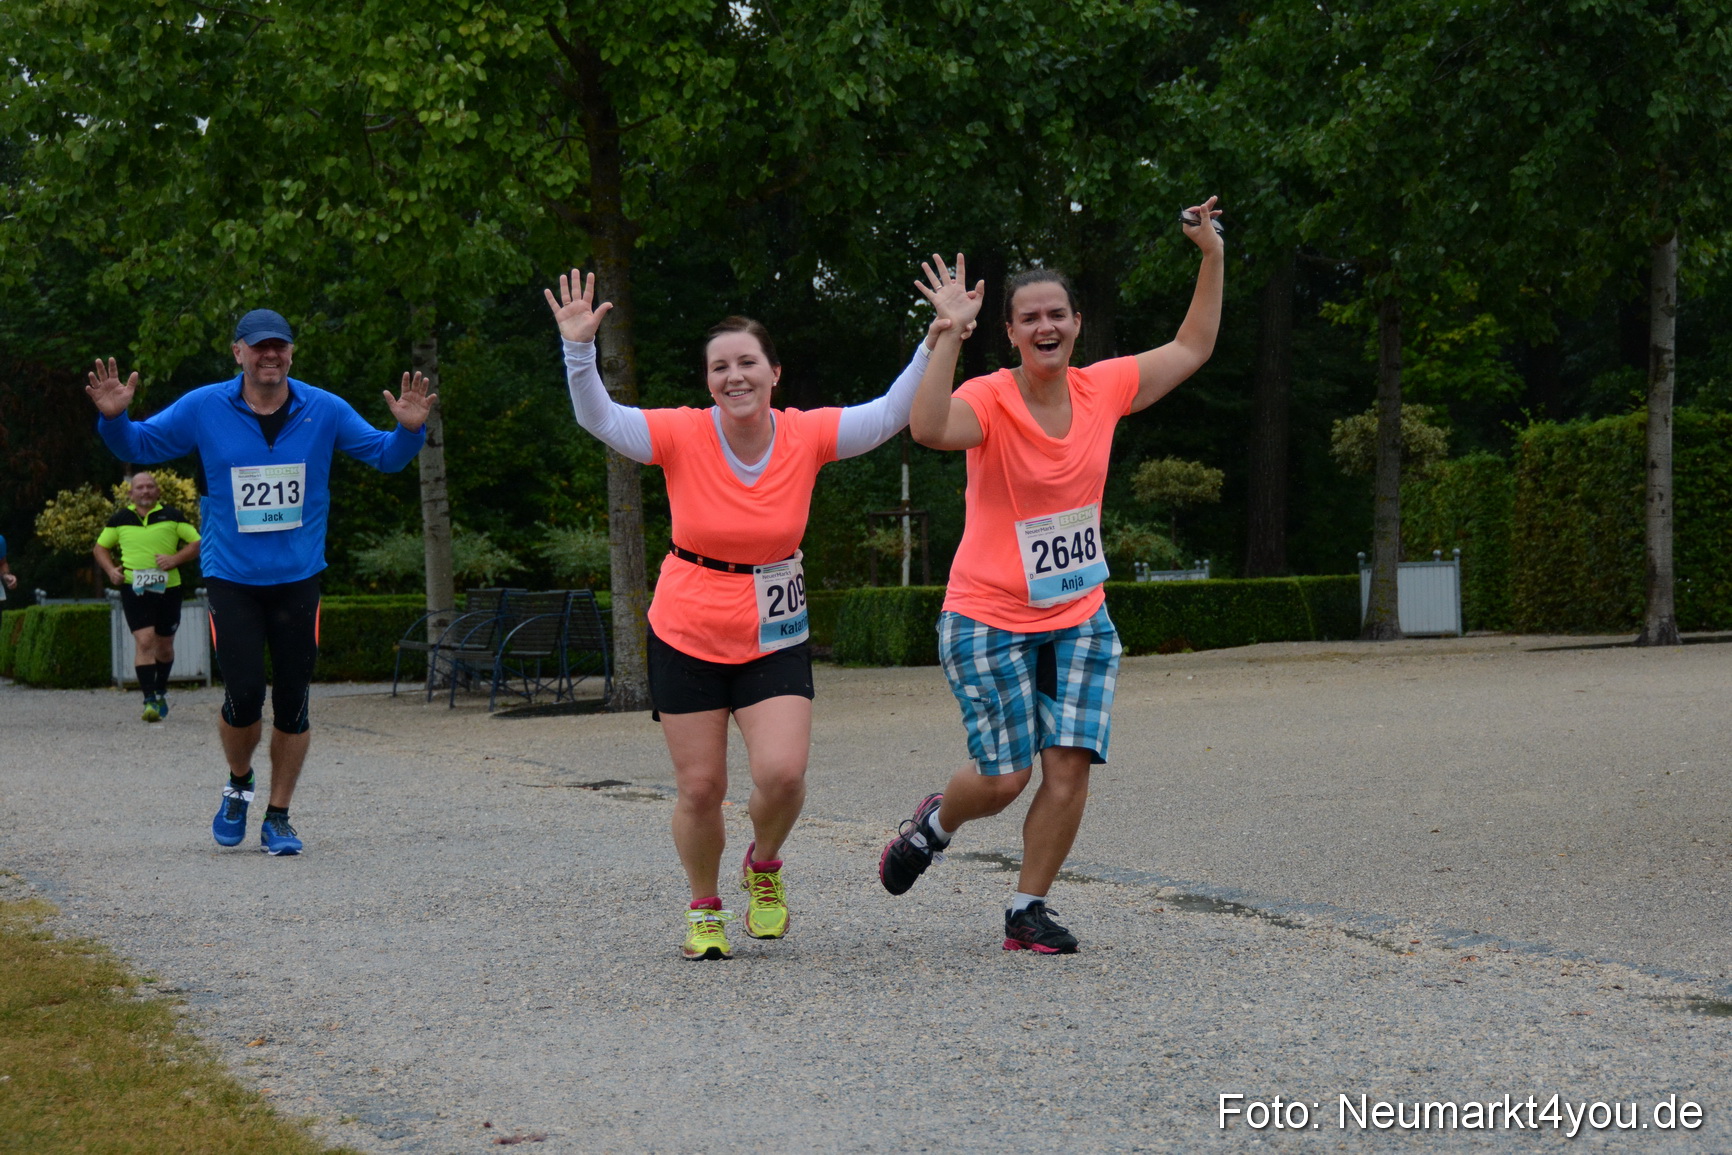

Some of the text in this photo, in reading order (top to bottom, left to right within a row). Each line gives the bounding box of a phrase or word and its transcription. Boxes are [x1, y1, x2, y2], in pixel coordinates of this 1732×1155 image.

[241, 480, 300, 507] 2213
[262, 512, 284, 522] Jack
[1059, 507, 1094, 527] BOCK
[1025, 525, 1055, 536] NeuerMarkt
[1031, 527, 1097, 574] 2648
[762, 570, 792, 580] NeuerMarkt
[1061, 575, 1084, 591] Anja
[767, 573, 806, 618] 209
